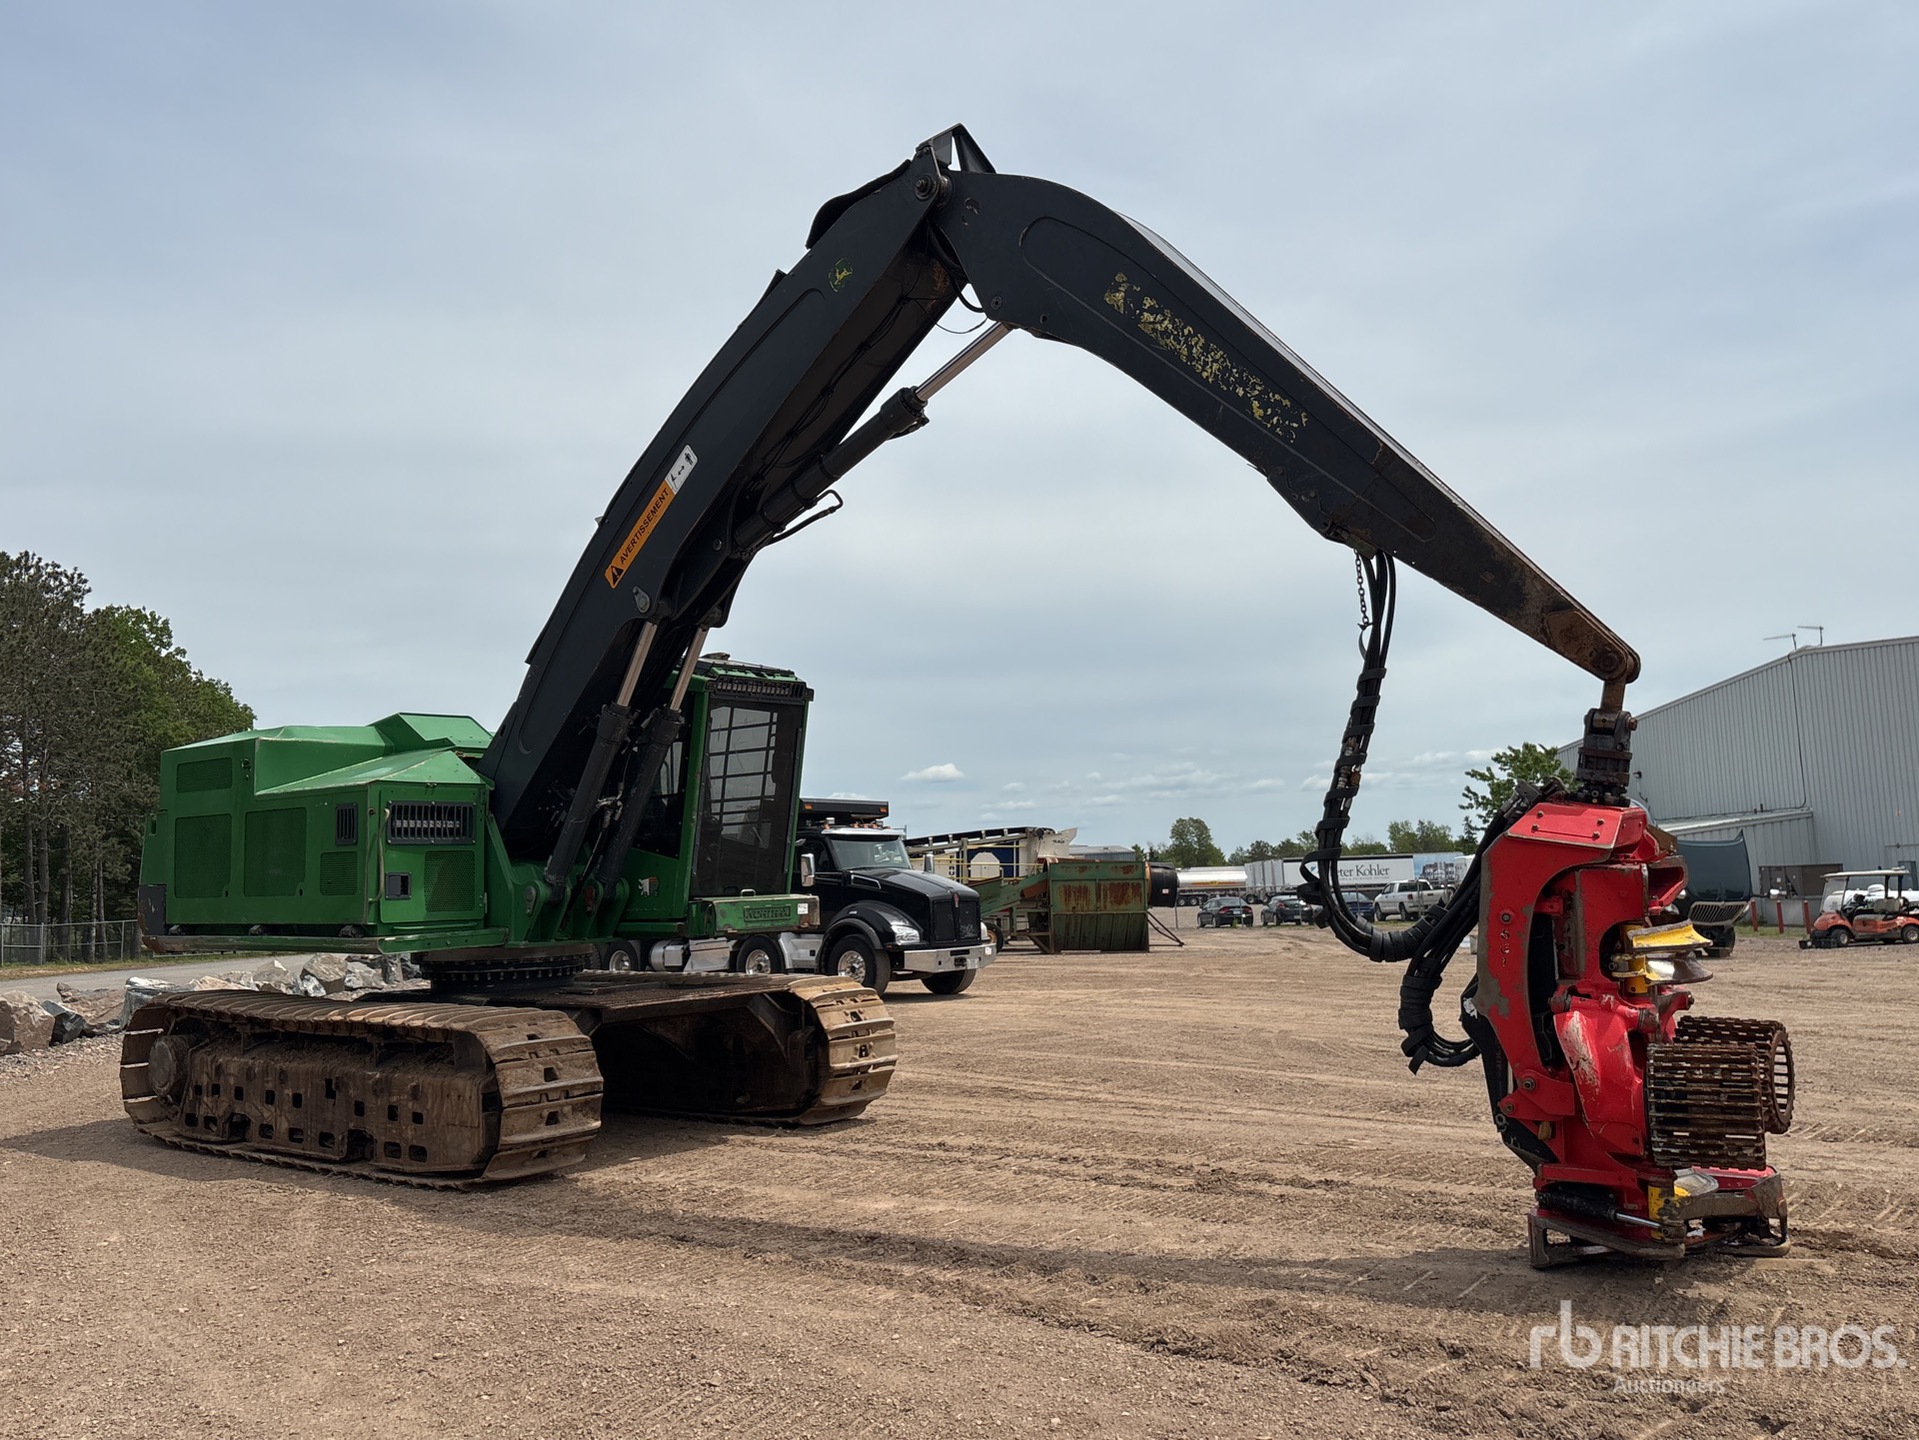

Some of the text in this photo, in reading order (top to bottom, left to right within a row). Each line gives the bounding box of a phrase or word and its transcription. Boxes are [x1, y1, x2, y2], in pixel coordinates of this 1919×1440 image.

[620, 488, 669, 564] AVERTISSEMENT
[1338, 864, 1390, 877] ter Kohler
